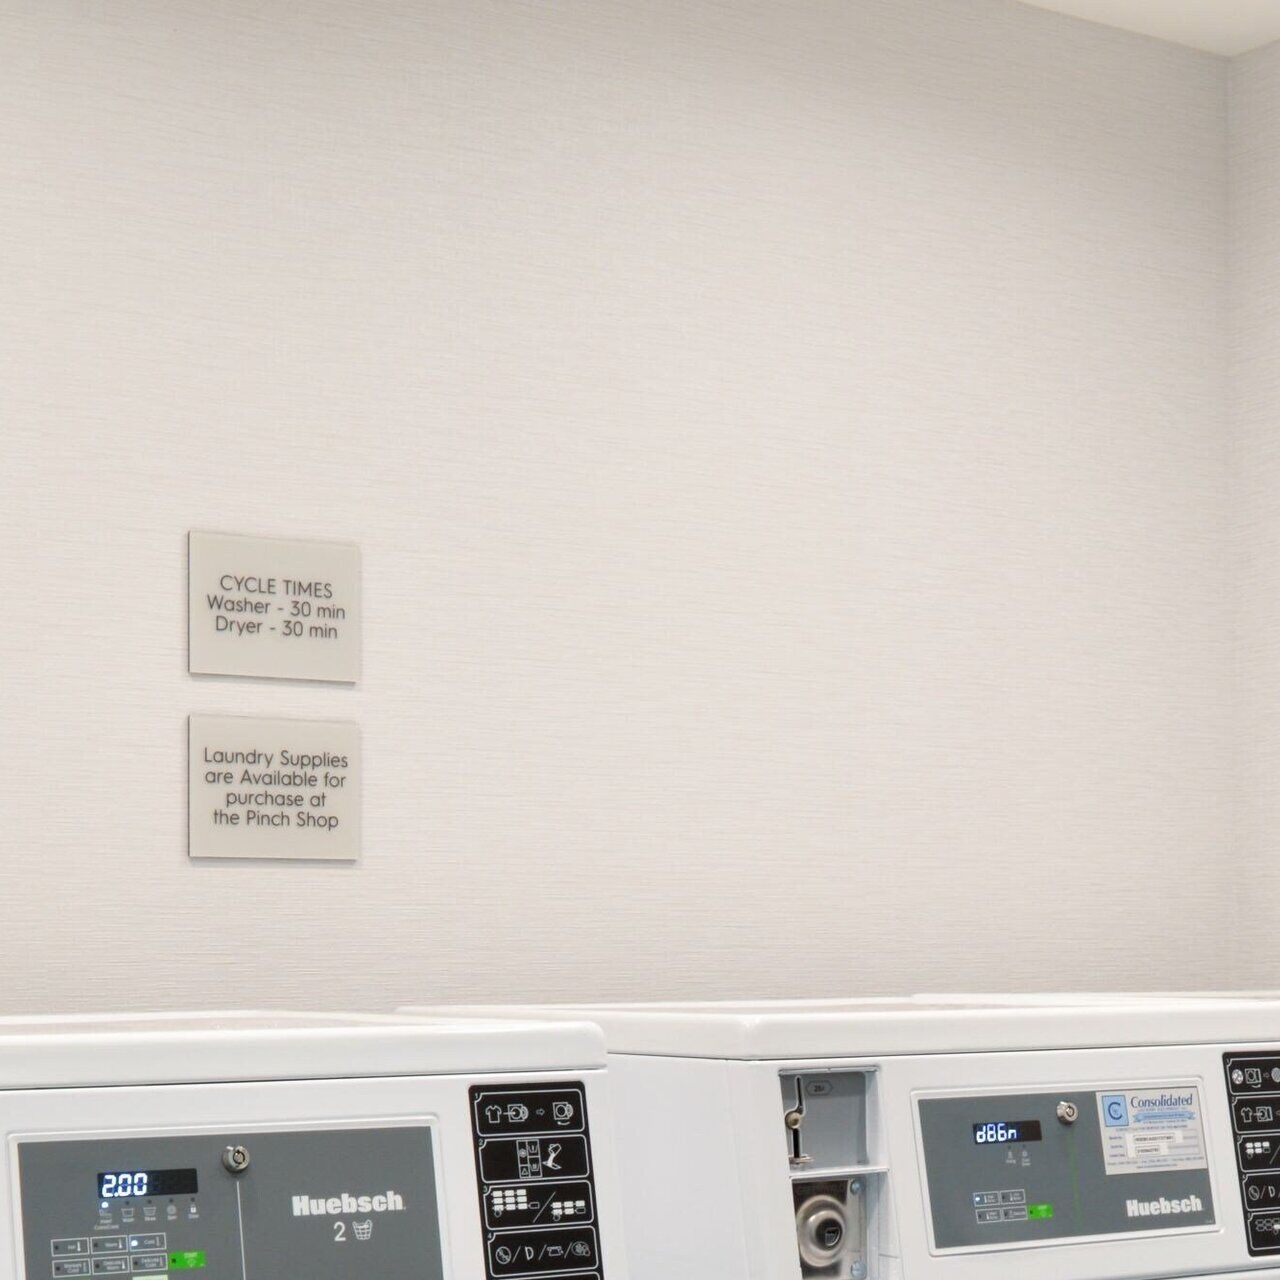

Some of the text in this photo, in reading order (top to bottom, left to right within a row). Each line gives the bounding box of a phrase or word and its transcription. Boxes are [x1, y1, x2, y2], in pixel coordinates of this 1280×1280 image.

[220, 575, 333, 599] CYCLE TIMES
[207, 595, 271, 614] Washer
[290, 601, 311, 617] 30
[317, 605, 346, 620] min
[216, 615, 263, 636] Dryer
[282, 621, 303, 637] 30
[309, 624, 338, 639] min
[204, 747, 348, 770] Laundry Supplies
[205, 769, 347, 788] are Available for
[226, 790, 327, 808] purchase at
[213, 810, 339, 831] the Pinch Shop
[1130, 1094, 1193, 1109] Consolidated
[101, 1173, 148, 1197] 2.00
[292, 1190, 403, 1216] Huebsch
[1126, 1195, 1203, 1217] Huebsch
[333, 1221, 347, 1242] 2
